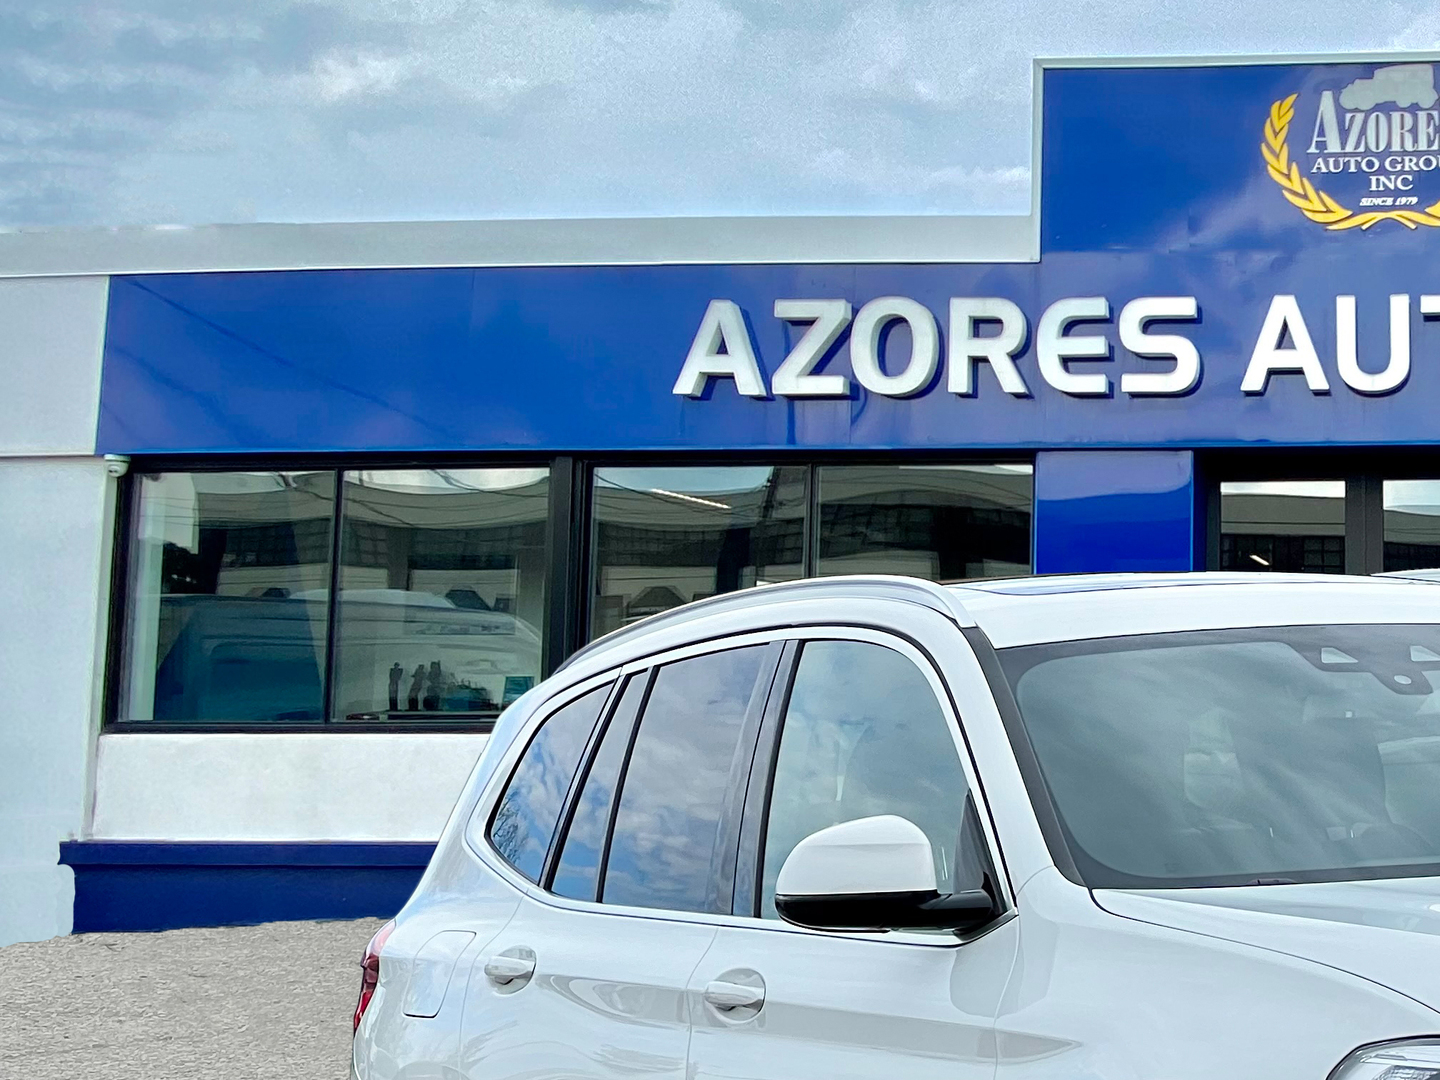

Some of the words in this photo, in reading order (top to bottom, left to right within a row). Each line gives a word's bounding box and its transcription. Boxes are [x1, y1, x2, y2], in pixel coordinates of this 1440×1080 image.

[1311, 155, 1380, 174] AUTO
[1369, 175, 1414, 191] INC
[1359, 197, 1394, 206] SINCE
[1395, 196, 1418, 206] 1979
[672, 295, 1201, 398] AZORES
